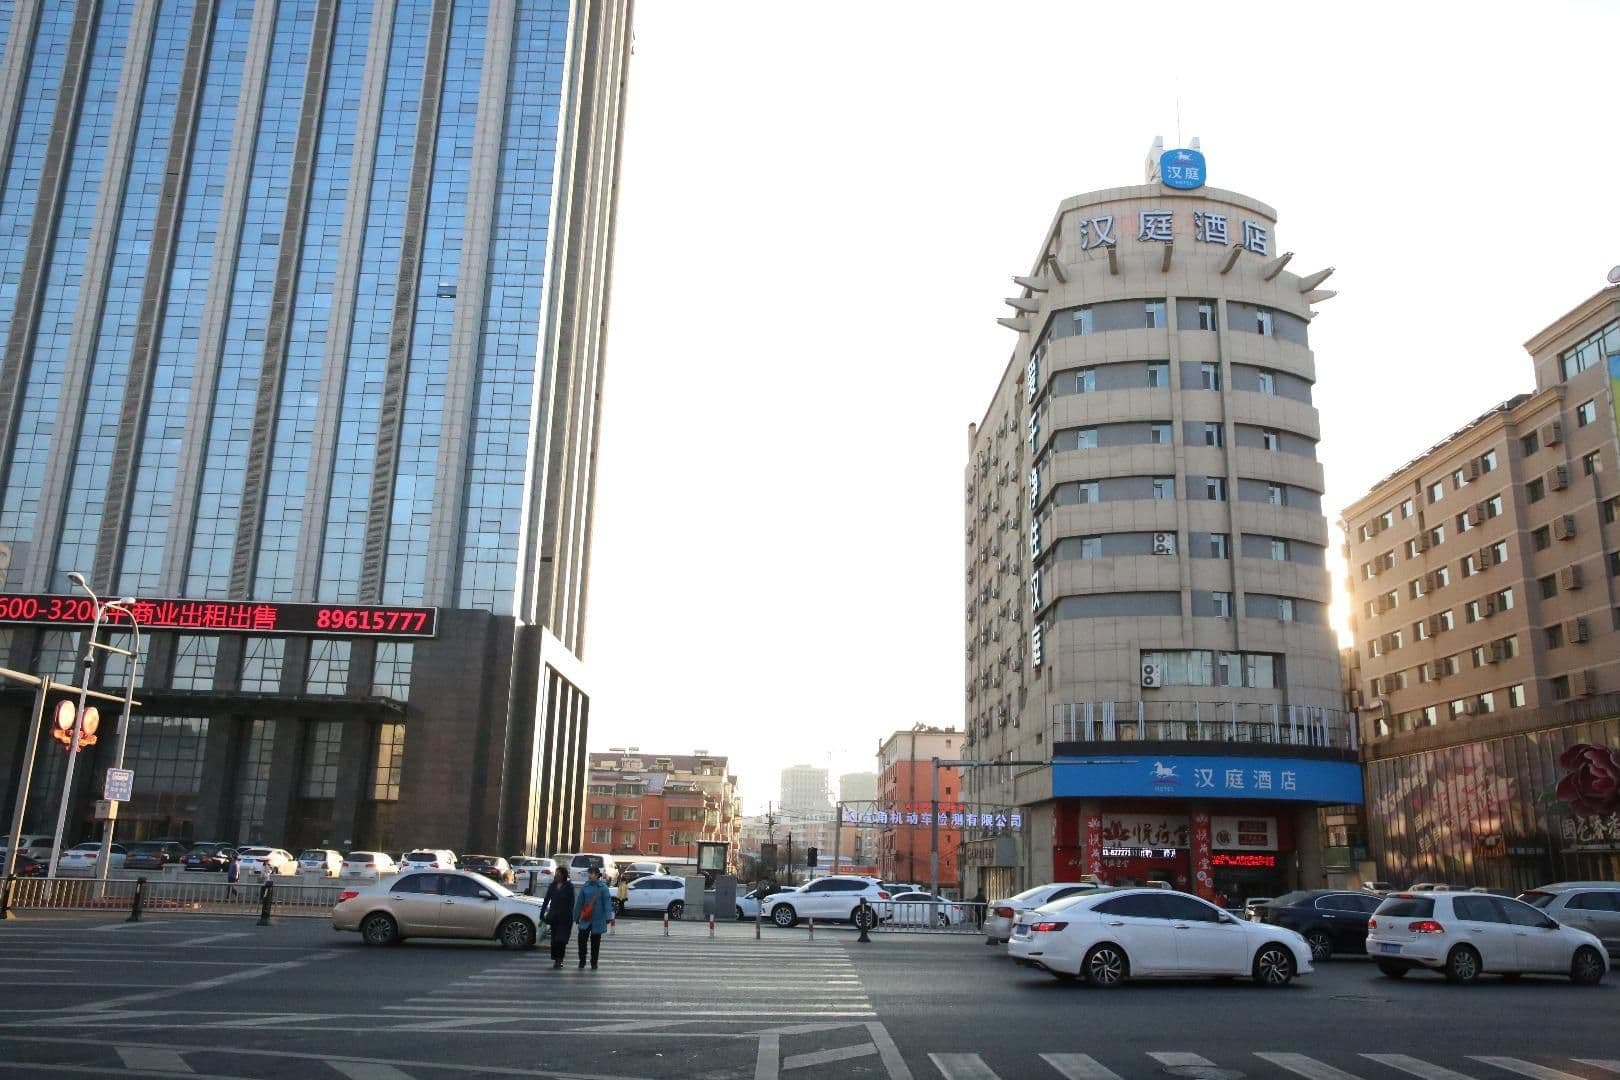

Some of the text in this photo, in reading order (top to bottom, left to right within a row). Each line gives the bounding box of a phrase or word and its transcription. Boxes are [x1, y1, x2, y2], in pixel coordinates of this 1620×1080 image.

[1167, 165, 1200, 181] 汉庭
[1080, 208, 1268, 257] 汉庭酒店
[316, 609, 428, 632] 89615777
[1194, 768, 1297, 791] 汉庭酒店
